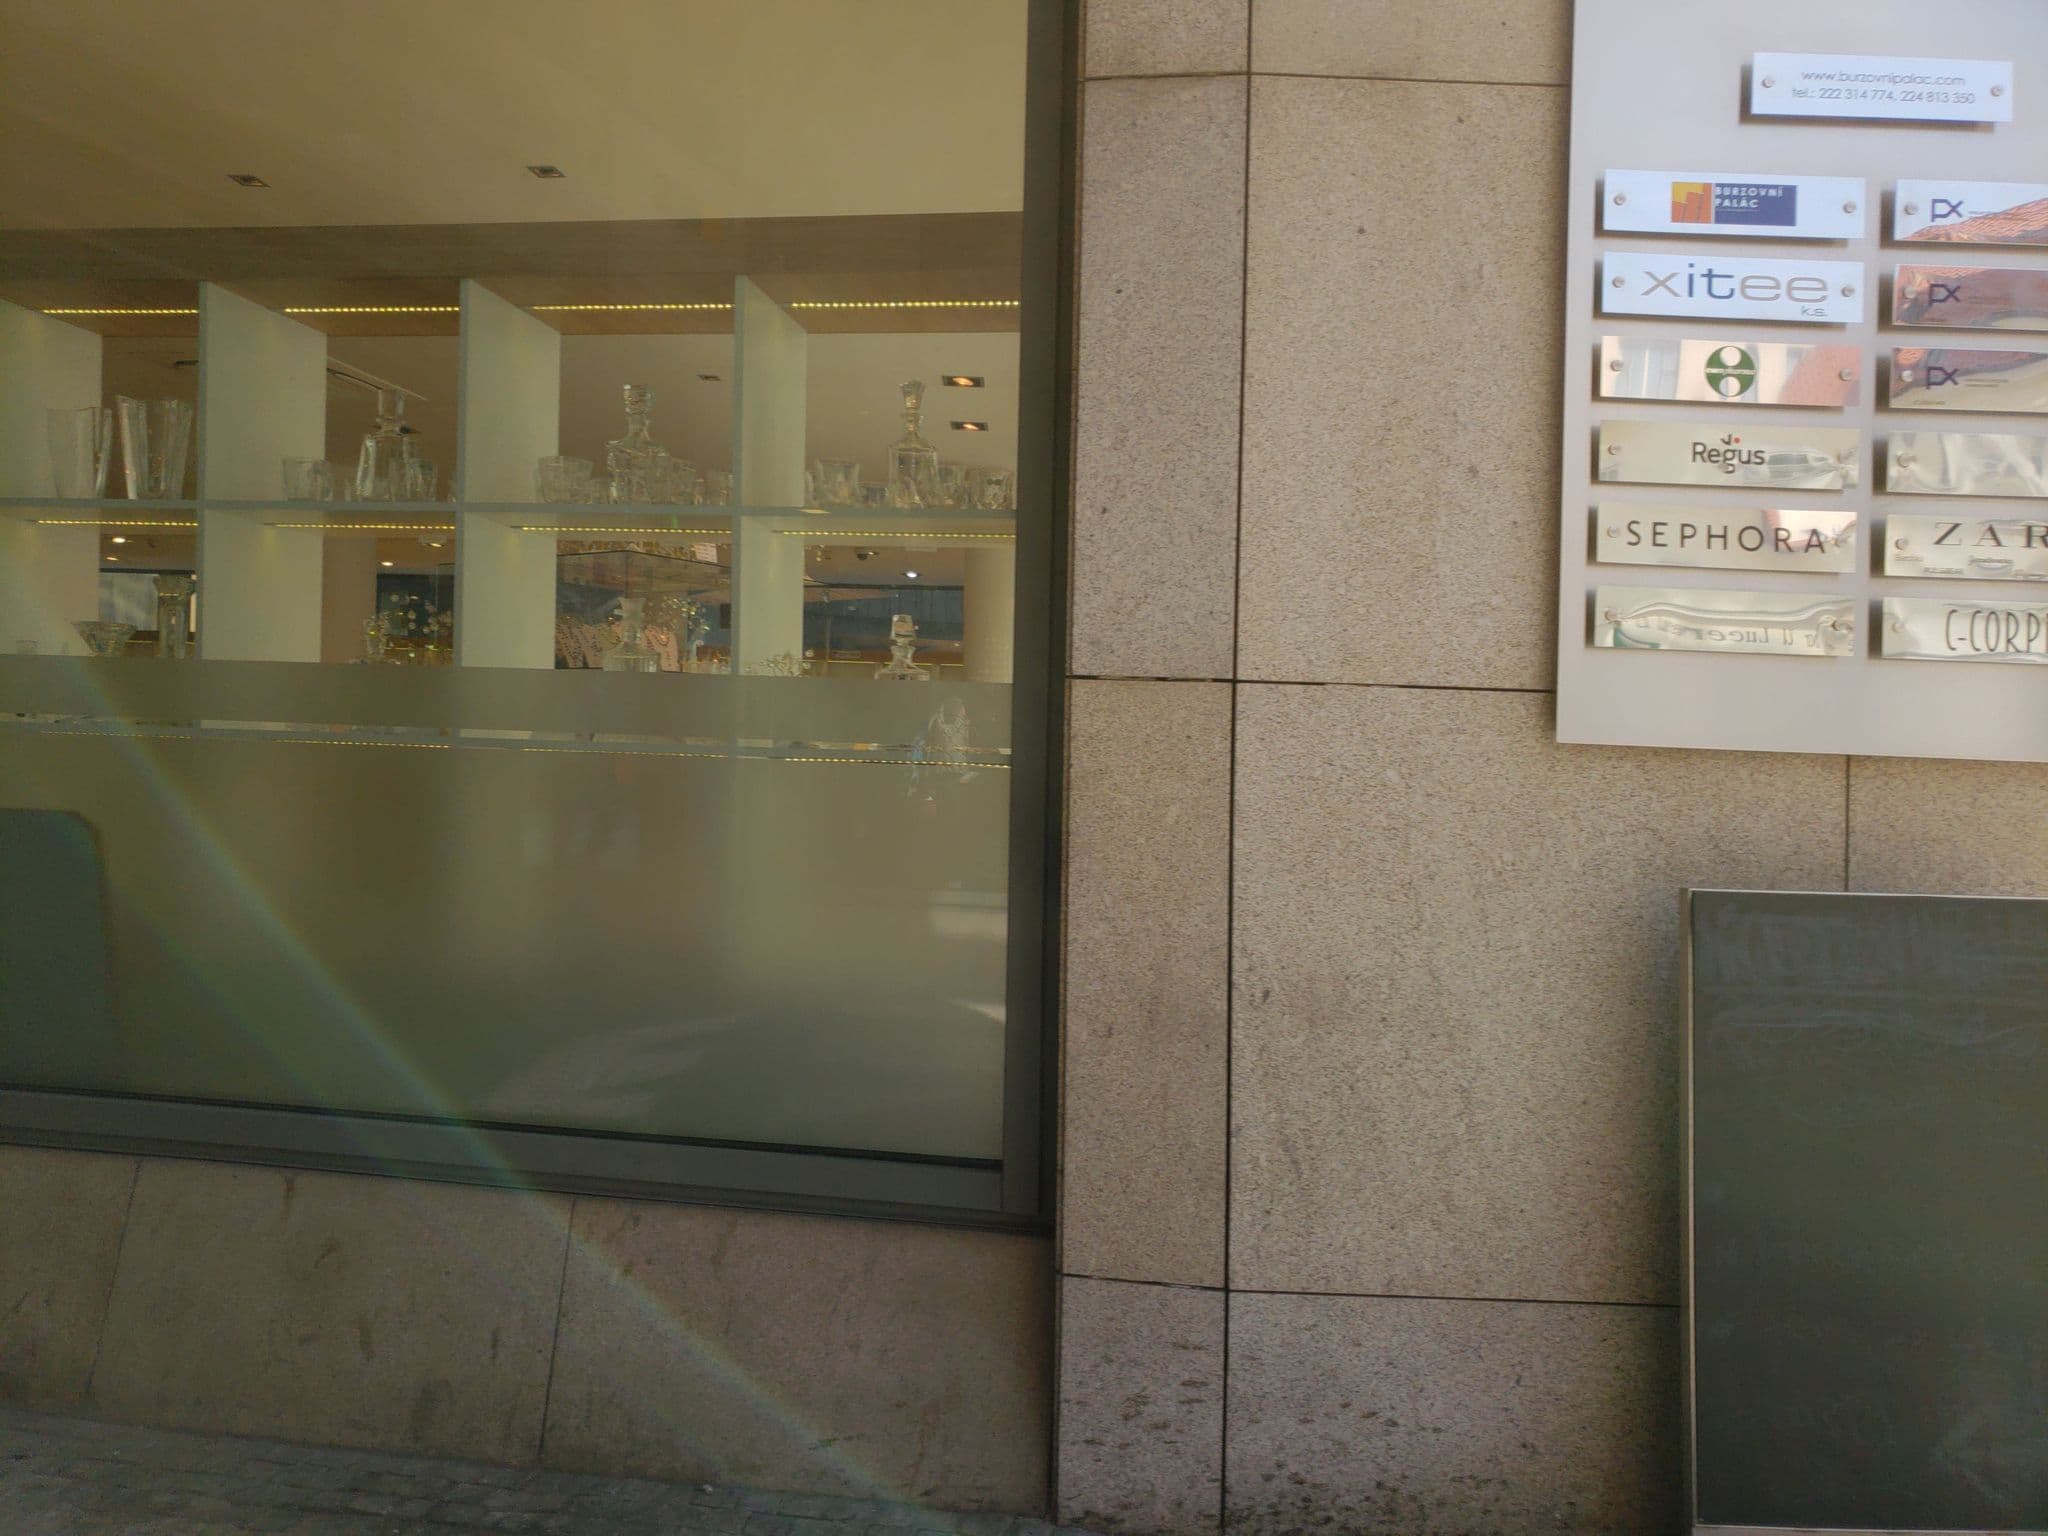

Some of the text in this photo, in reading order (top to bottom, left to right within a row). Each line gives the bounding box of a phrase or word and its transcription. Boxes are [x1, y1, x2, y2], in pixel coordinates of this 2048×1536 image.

[1801, 70, 1966, 86] www.burzovnipalac.com
[1819, 88, 1841, 99] 222
[1845, 89, 1868, 100] 314
[1900, 90, 1924, 102] 224
[1927, 91, 1950, 103] 813
[1953, 92, 1976, 104] 350
[1641, 263, 1828, 303] xitee
[1692, 441, 1766, 474] Regus
[1627, 520, 1826, 553] SEPHORA
[1945, 609, 2048, 653] C-CORP
